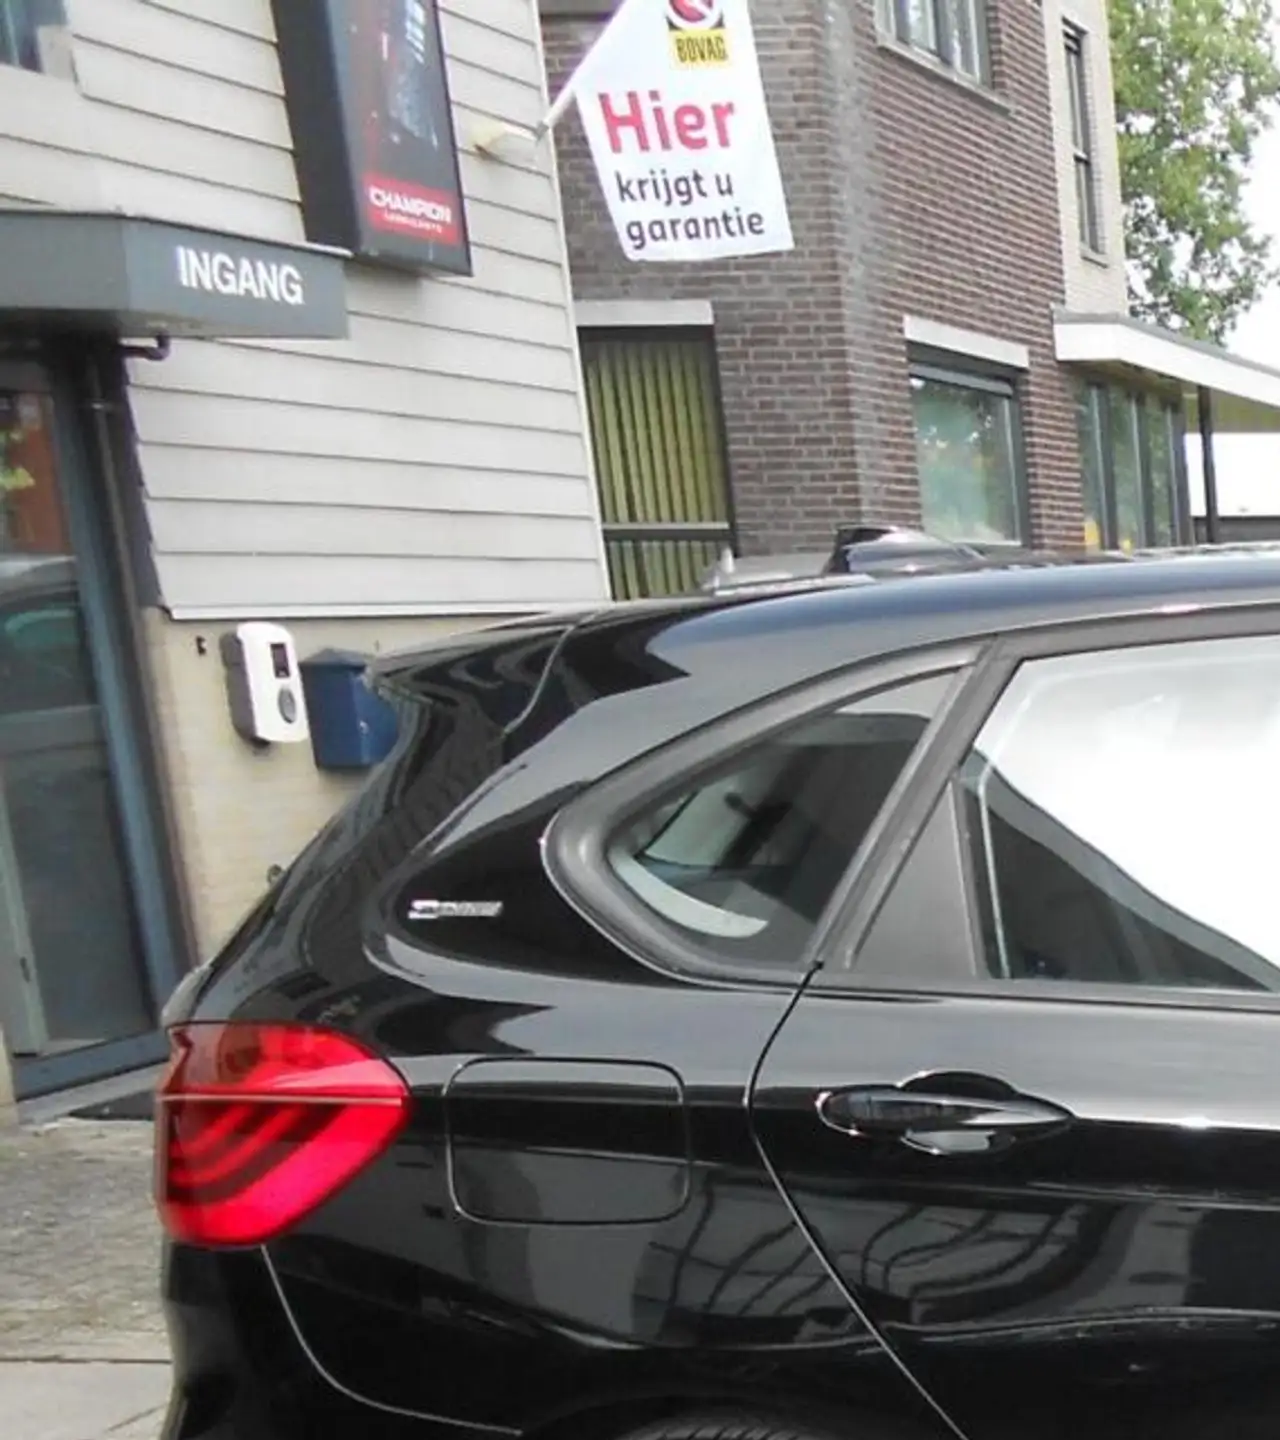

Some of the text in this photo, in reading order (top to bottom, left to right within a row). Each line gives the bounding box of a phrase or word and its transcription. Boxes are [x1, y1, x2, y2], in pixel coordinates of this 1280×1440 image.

[675, 35, 728, 63] BOVAG
[598, 89, 735, 154] Hier
[614, 168, 734, 206] krijgt u
[626, 206, 765, 250] garantie
[176, 245, 305, 305] INGANG
